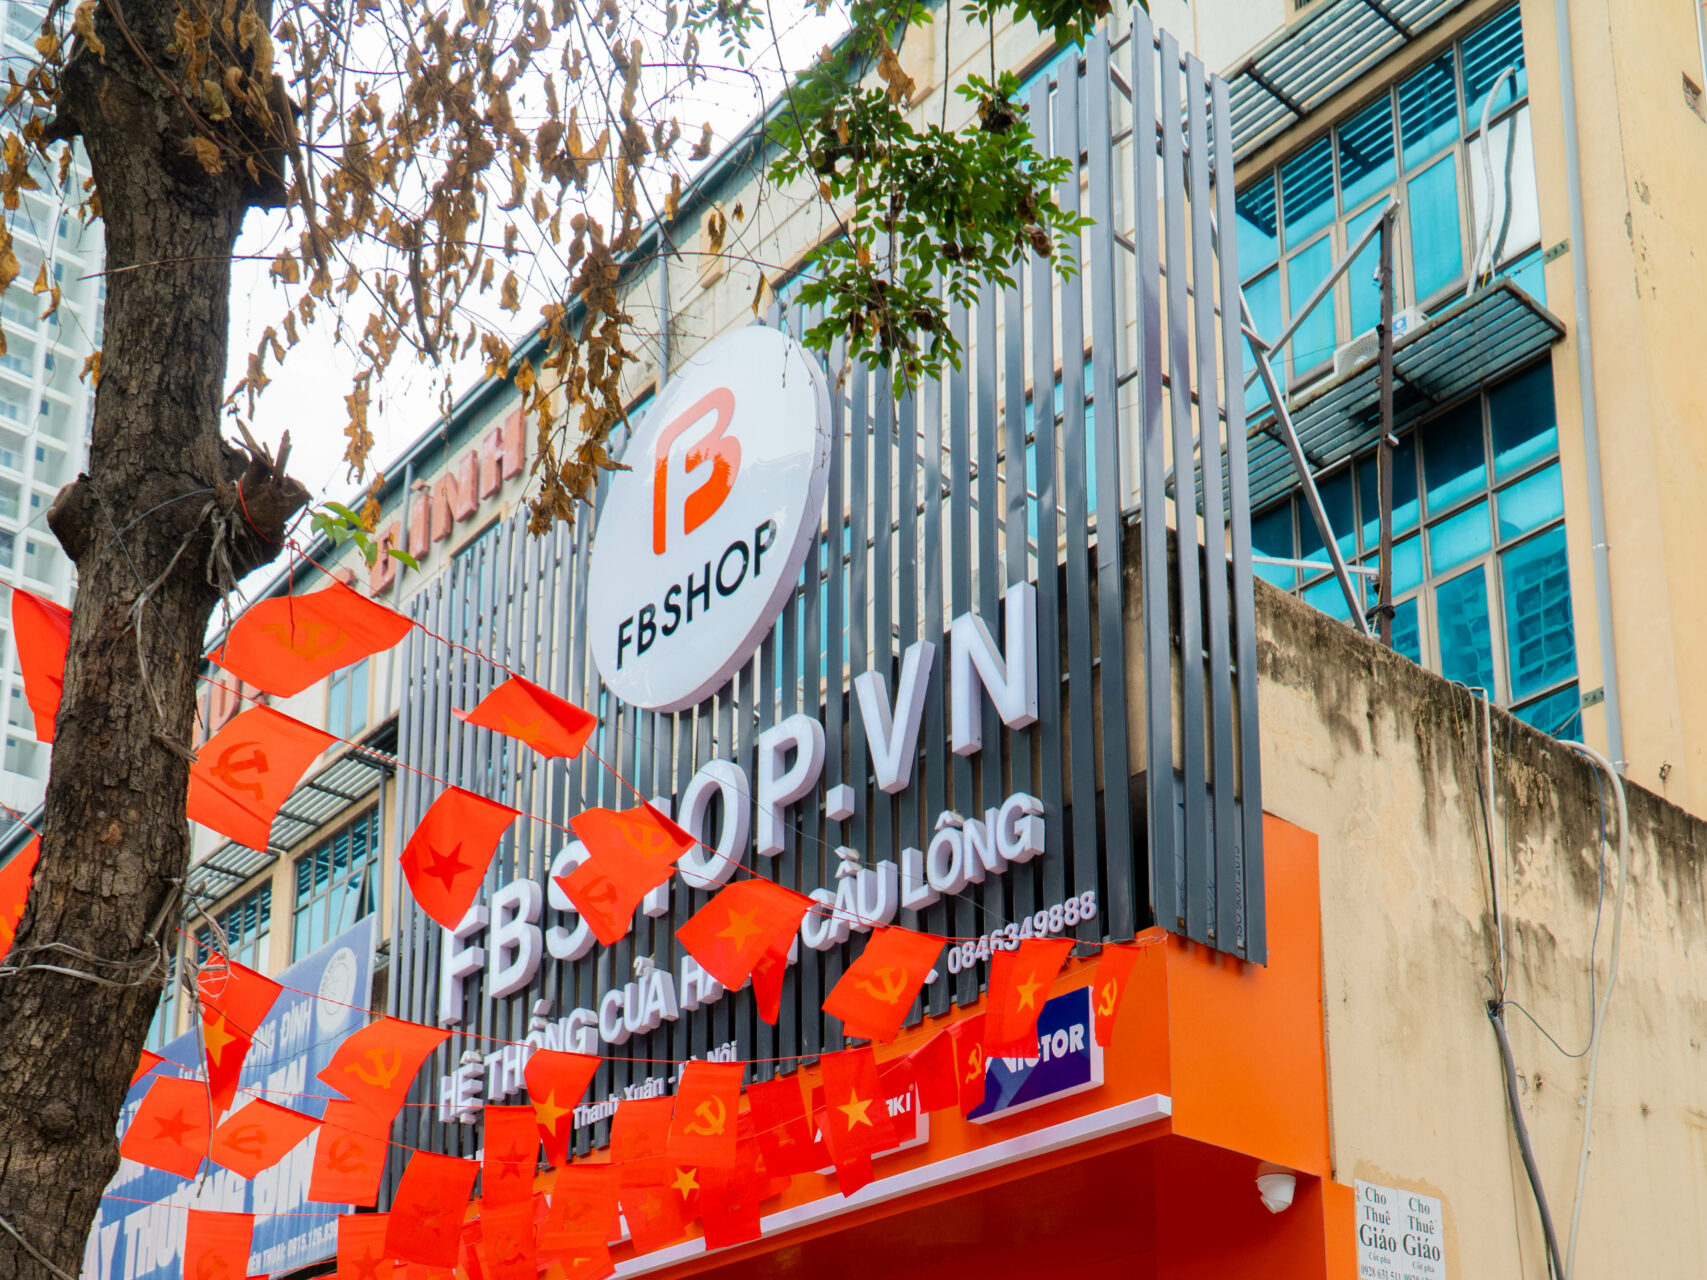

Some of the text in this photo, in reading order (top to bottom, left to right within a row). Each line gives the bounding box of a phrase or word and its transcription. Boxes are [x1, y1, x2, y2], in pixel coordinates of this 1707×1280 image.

[616, 519, 776, 670] FBSHOP
[439, 580, 1039, 1025] FBSOP.VN
[599, 956, 679, 1045] CỬA
[800, 847, 899, 952] CẦU
[901, 791, 1046, 912] LÔNG
[947, 889, 1098, 975] 0846349888
[1365, 1186, 1387, 1206] Cho
[1408, 1197, 1430, 1216] Cho
[1363, 1204, 1391, 1226] Thuê
[1407, 1215, 1435, 1235] Thuê
[1359, 1224, 1397, 1253] Giáo
[1402, 1234, 1441, 1262] Giáo
[1360, 1263, 1376, 1277] 0928
[1377, 1268, 1389, 1280] 631
